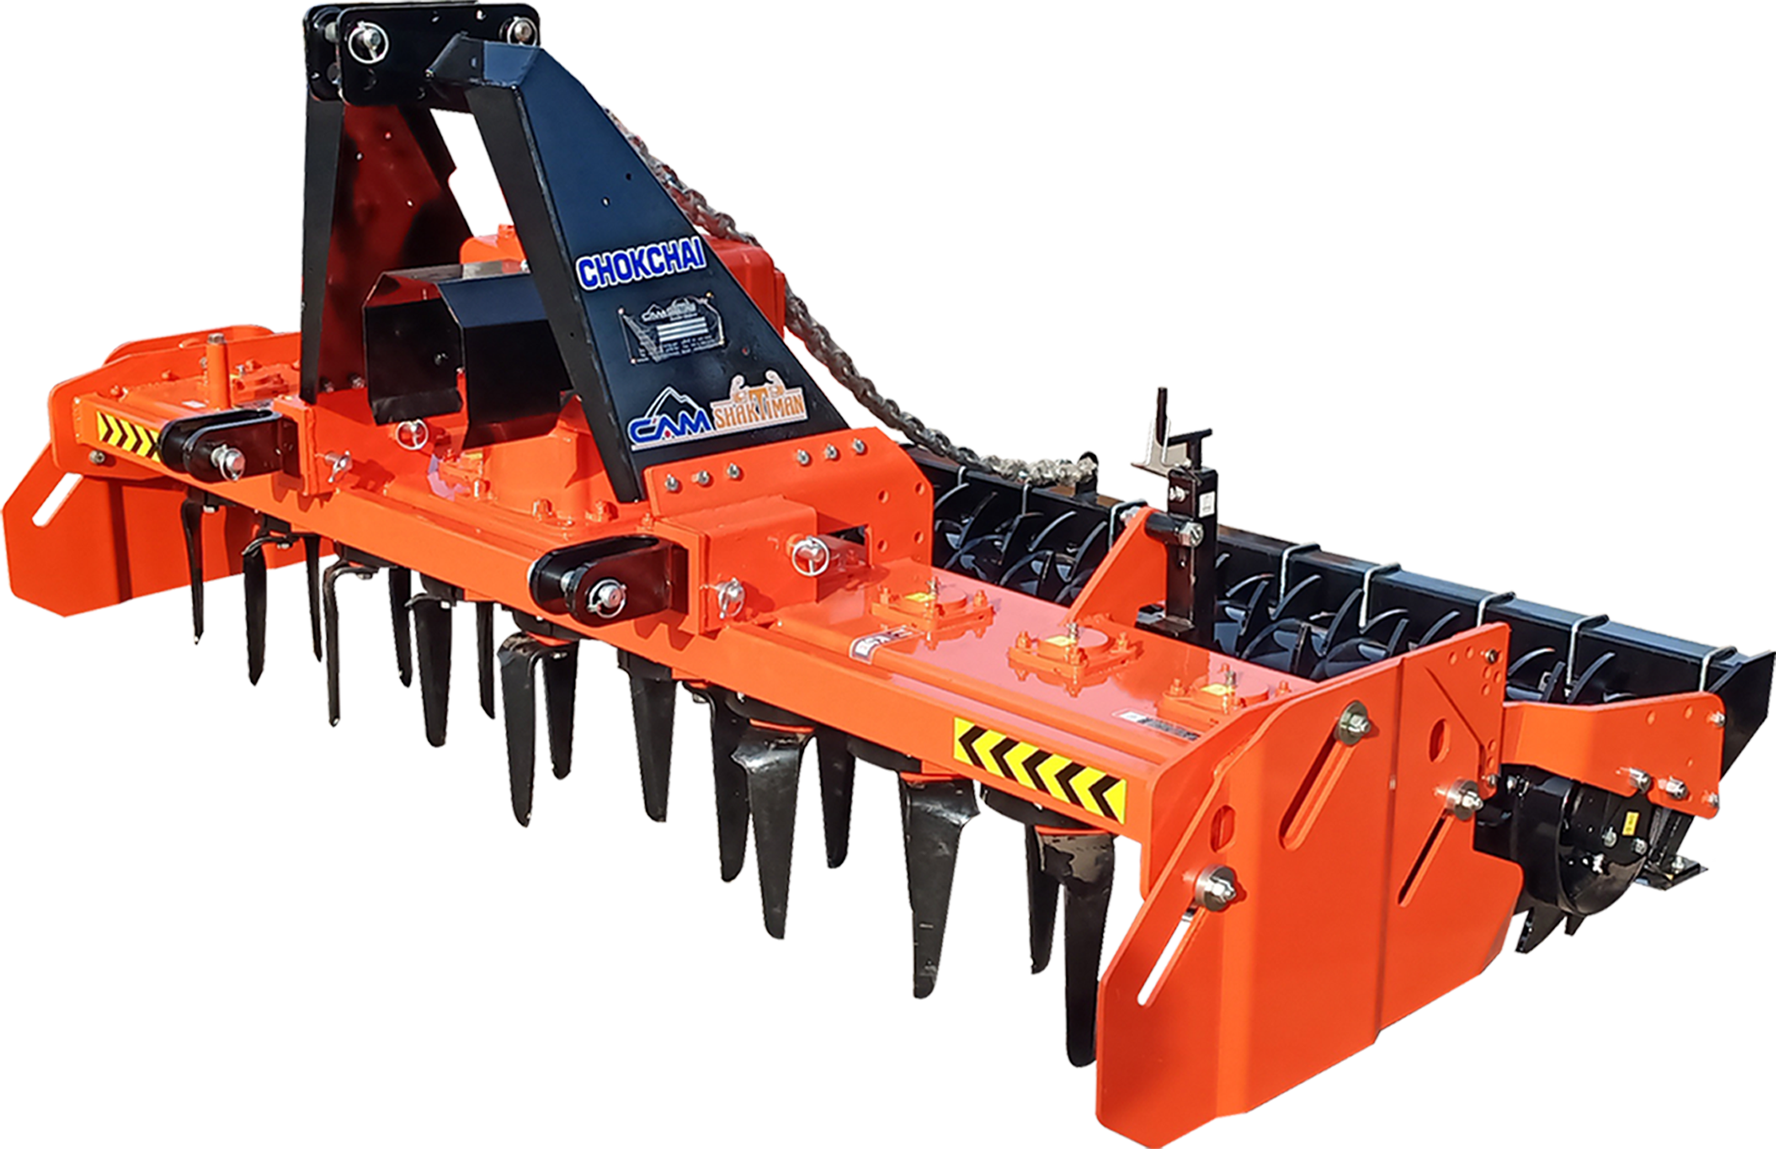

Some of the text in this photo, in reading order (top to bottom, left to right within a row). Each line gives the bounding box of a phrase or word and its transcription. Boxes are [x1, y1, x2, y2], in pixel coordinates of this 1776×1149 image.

[577, 237, 706, 290] CHOKCHAI
[629, 387, 805, 443] CAM SHAKTIMAN
